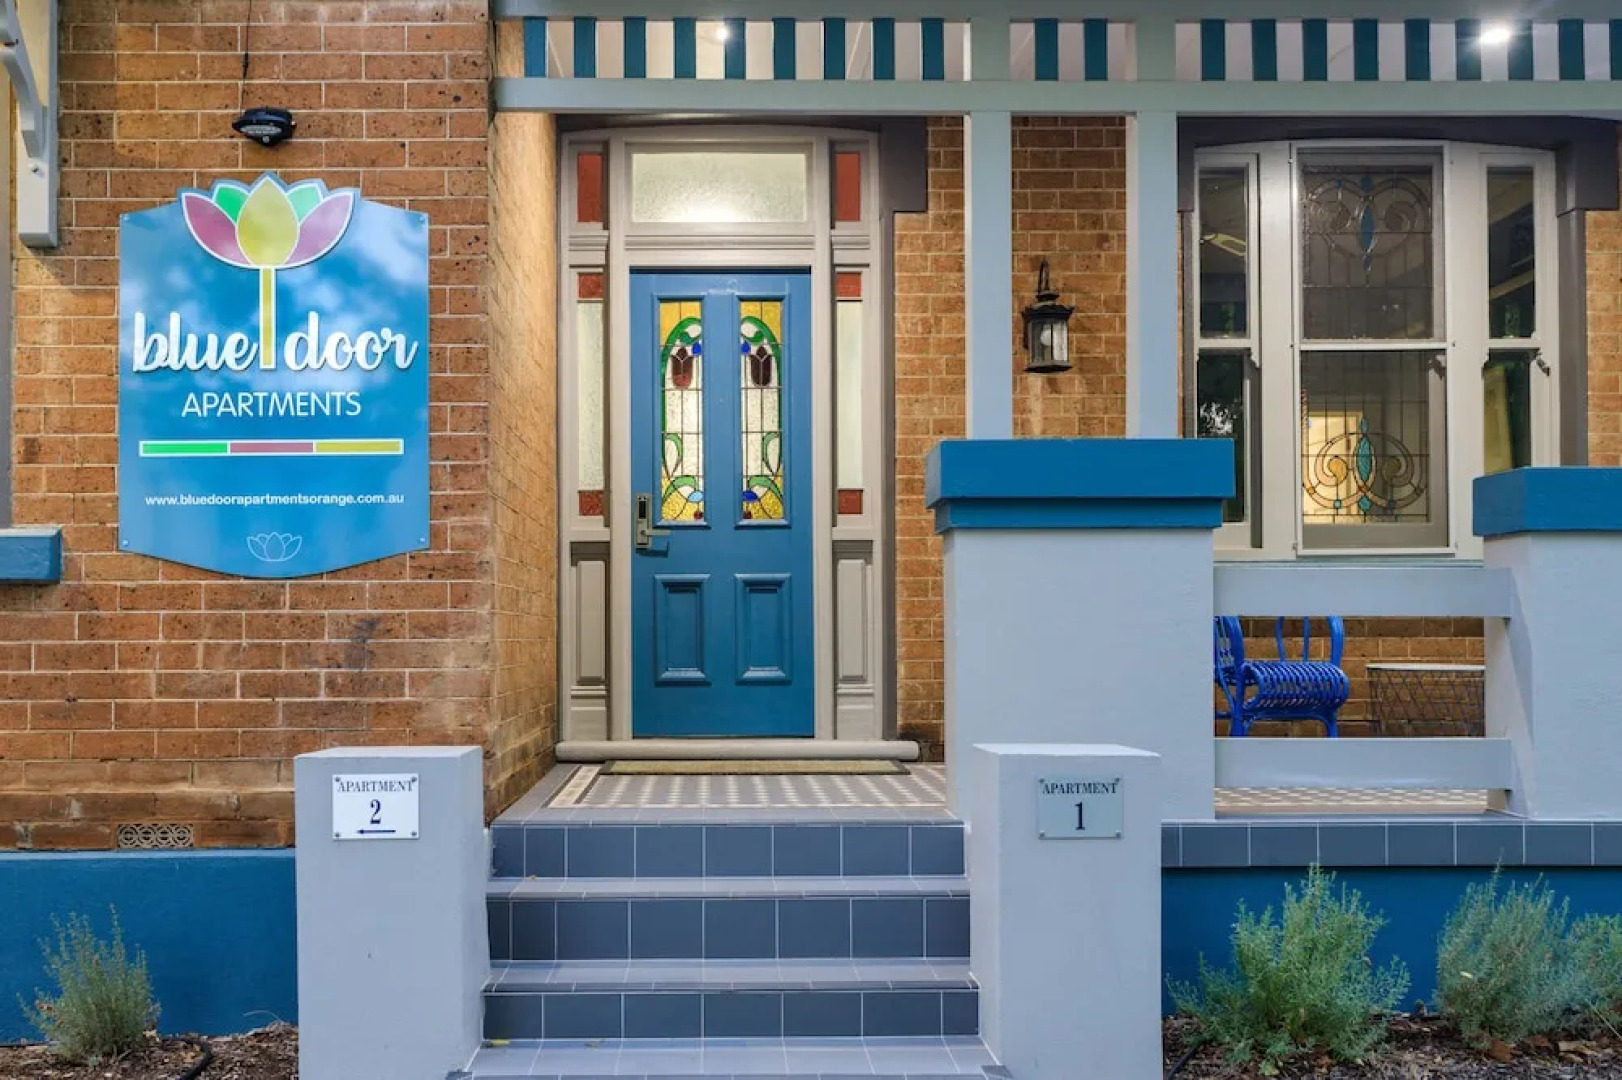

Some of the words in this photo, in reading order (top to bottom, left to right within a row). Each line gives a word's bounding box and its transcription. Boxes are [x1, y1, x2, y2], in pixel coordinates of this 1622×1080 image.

[132, 311, 259, 373] blue
[283, 310, 418, 371] door
[181, 392, 362, 418] APARTMENTS
[145, 493, 405, 506] www.bluedoorapartmentsorange.com.au
[337, 780, 414, 792] APARTMENT
[1042, 782, 1118, 794] APARTMENT
[370, 799, 381, 824] 2
[1075, 801, 1086, 831] 1
